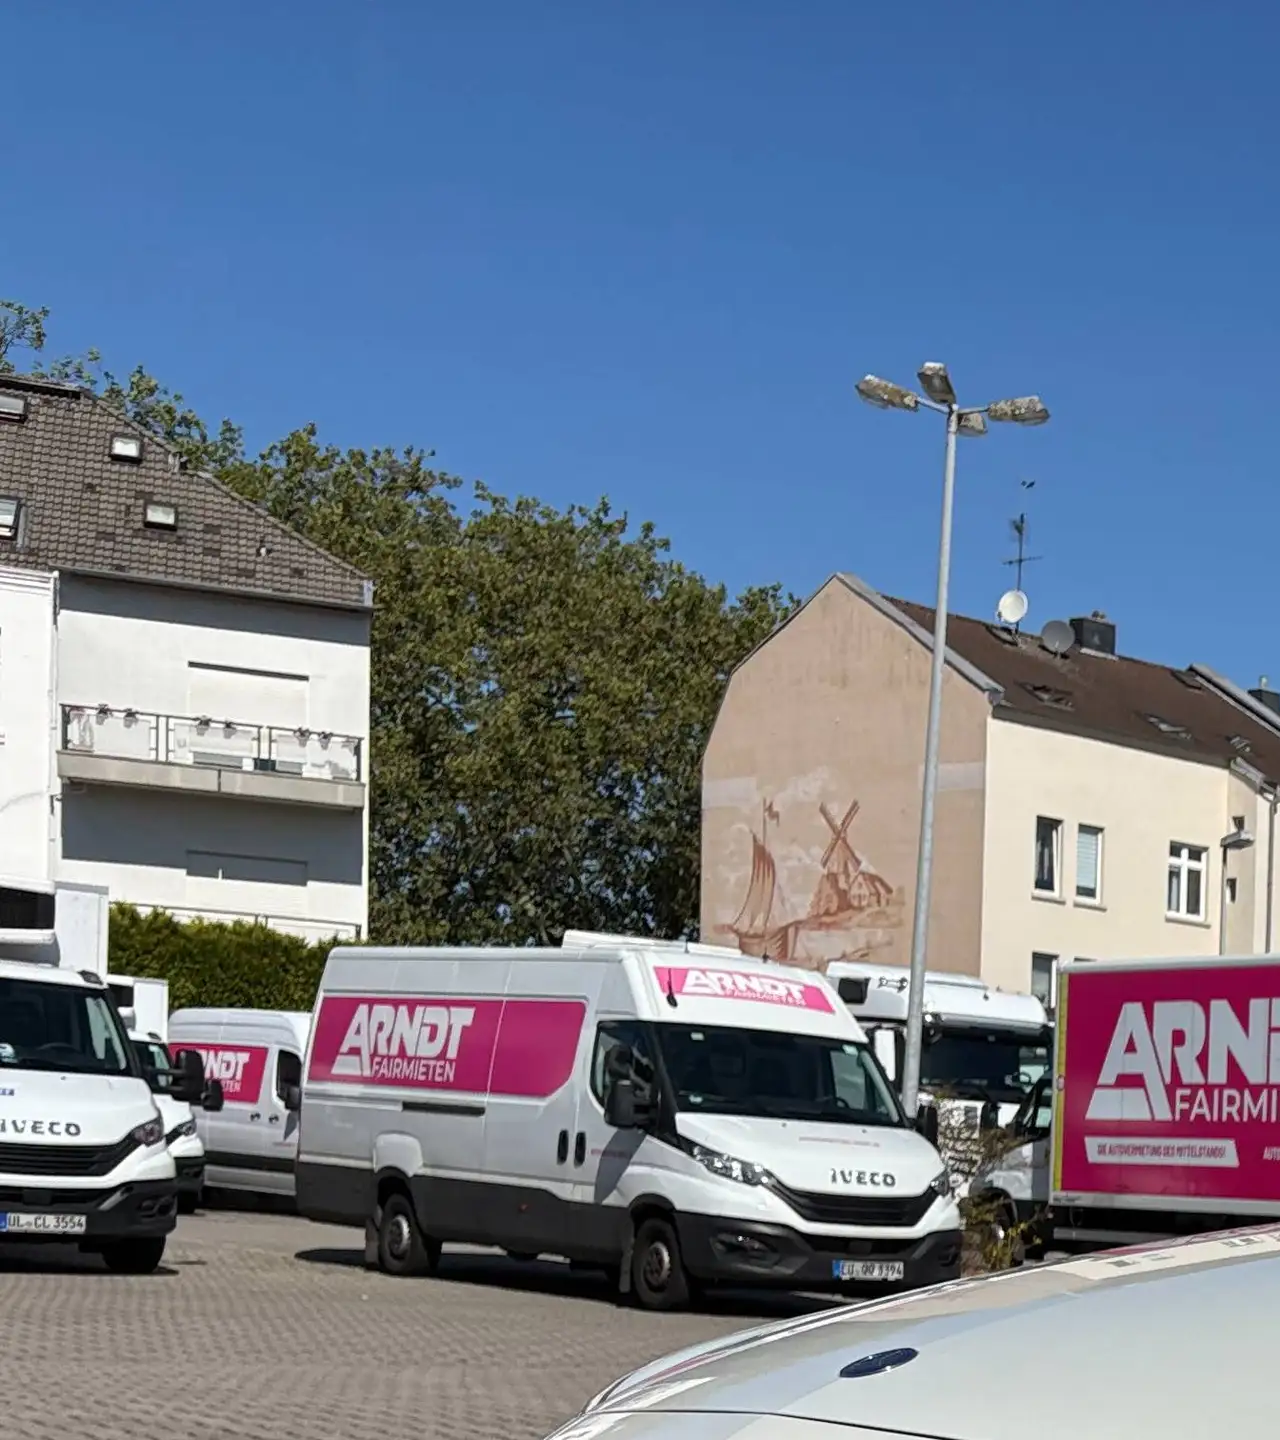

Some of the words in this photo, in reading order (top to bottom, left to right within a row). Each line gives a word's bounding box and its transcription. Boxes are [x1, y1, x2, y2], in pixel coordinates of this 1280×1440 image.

[682, 969, 806, 1000] ARNDT
[330, 1003, 476, 1078] ARNDT
[200, 1049, 251, 1080] NDT
[372, 1056, 456, 1083] FAIRMIETEN
[0, 1118, 81, 1137] IVECO
[831, 1168, 896, 1187] IVECO
